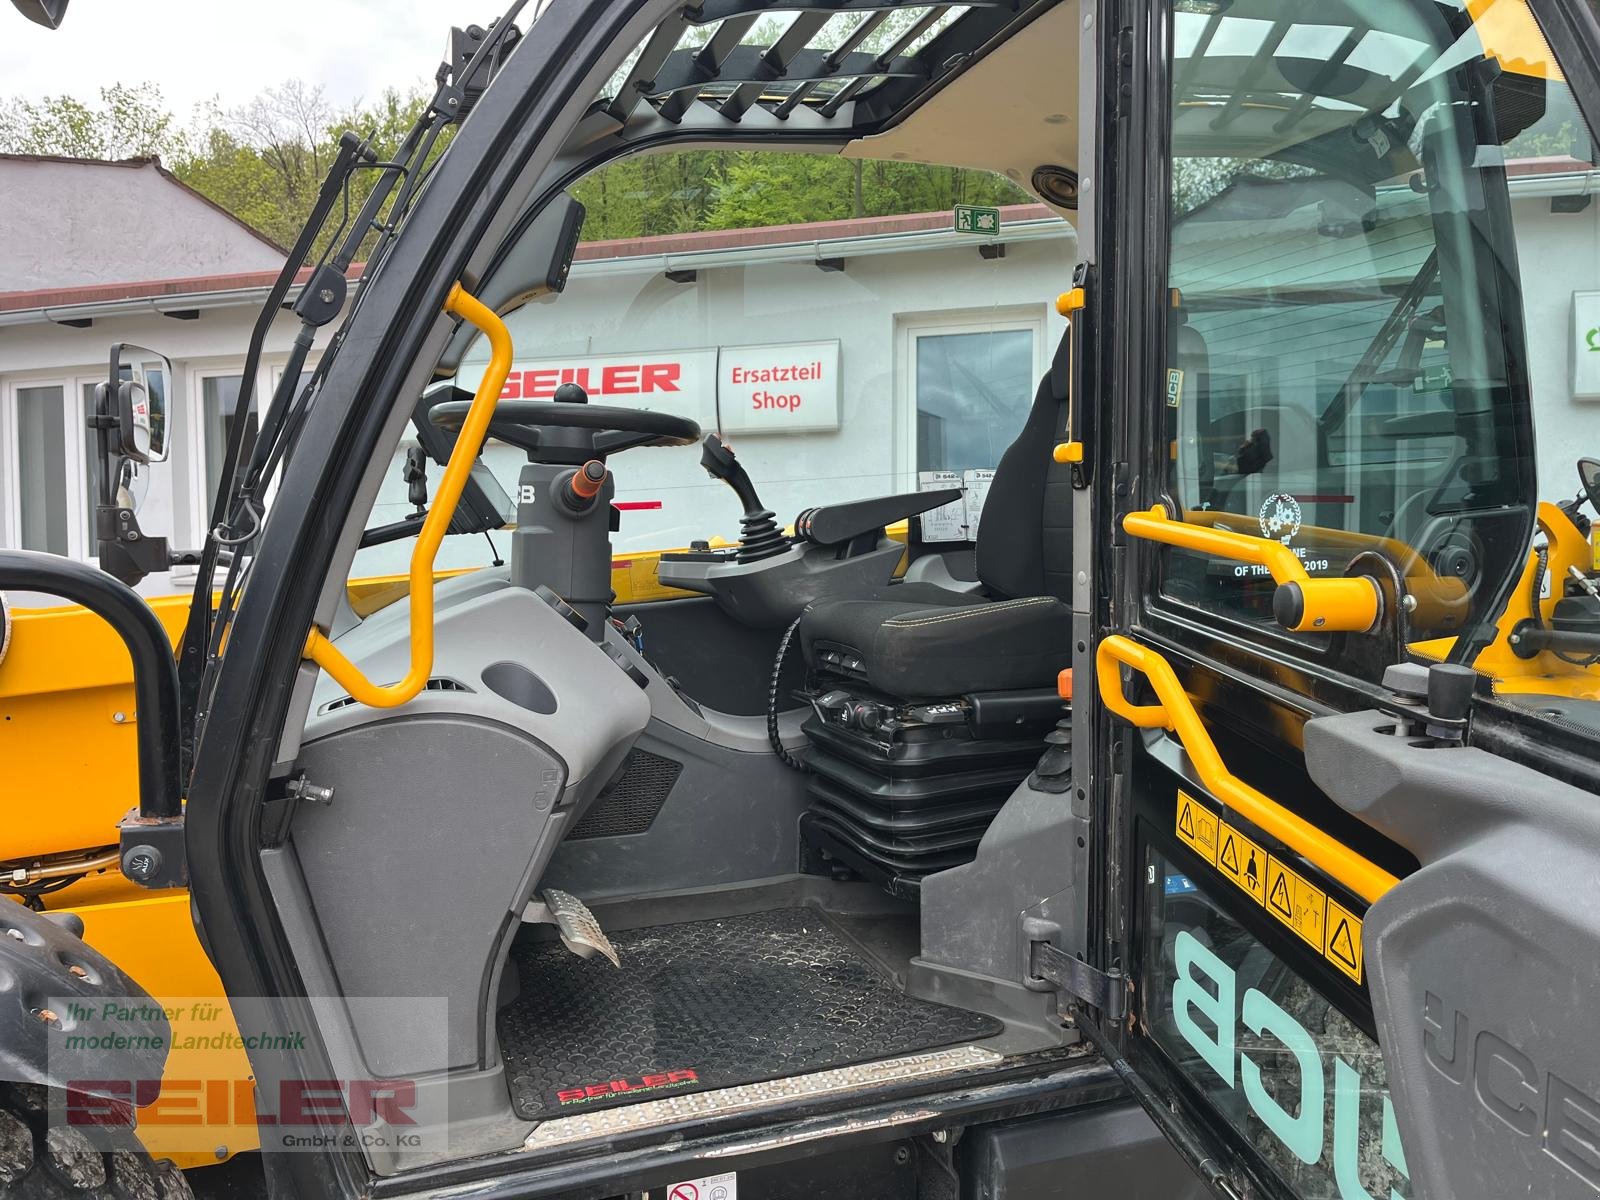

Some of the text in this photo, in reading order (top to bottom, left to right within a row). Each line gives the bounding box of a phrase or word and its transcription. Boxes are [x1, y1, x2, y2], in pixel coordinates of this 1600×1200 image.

[732, 361, 821, 384] Ersatzteil
[1168, 372, 1180, 405] JCB
[752, 391, 801, 412] Shop
[1234, 560, 1328, 576] OF THE 2019
[557, 1070, 699, 1102] SEILER
